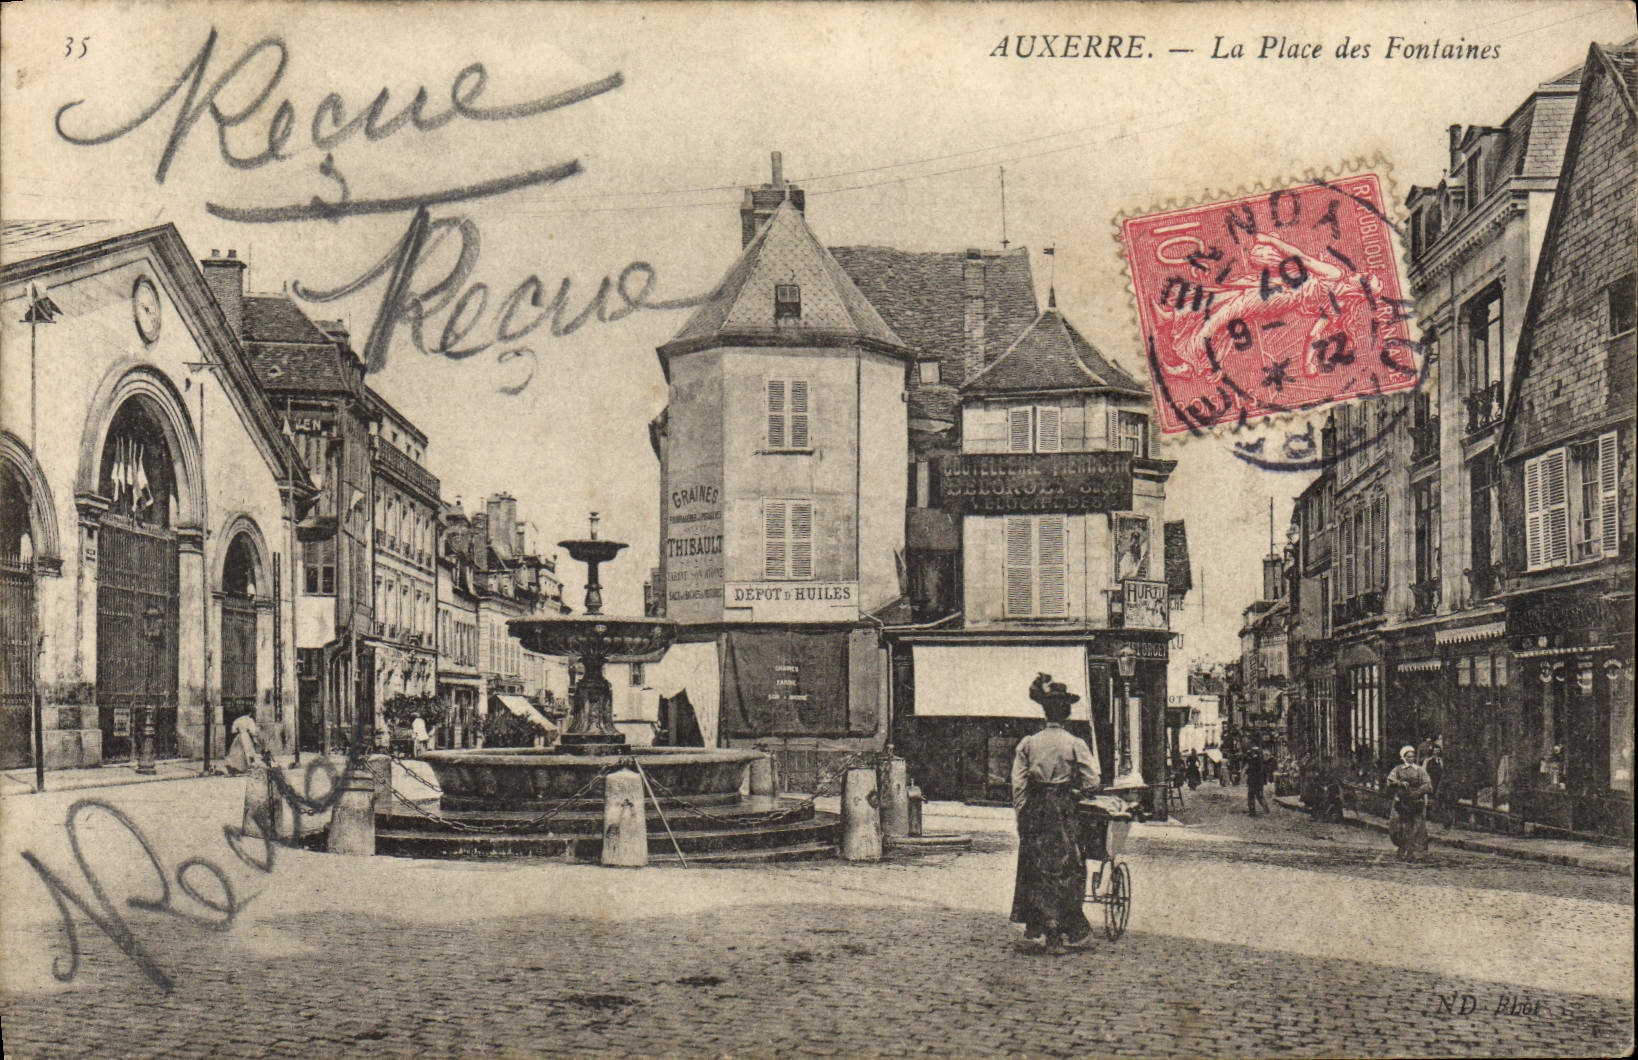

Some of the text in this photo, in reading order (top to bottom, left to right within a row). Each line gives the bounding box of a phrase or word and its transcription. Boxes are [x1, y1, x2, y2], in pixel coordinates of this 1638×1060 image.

[671, 485, 719, 509] GRAINES
[667, 535, 724, 558] THIBAULT
[1126, 583, 1166, 602] HURTU
